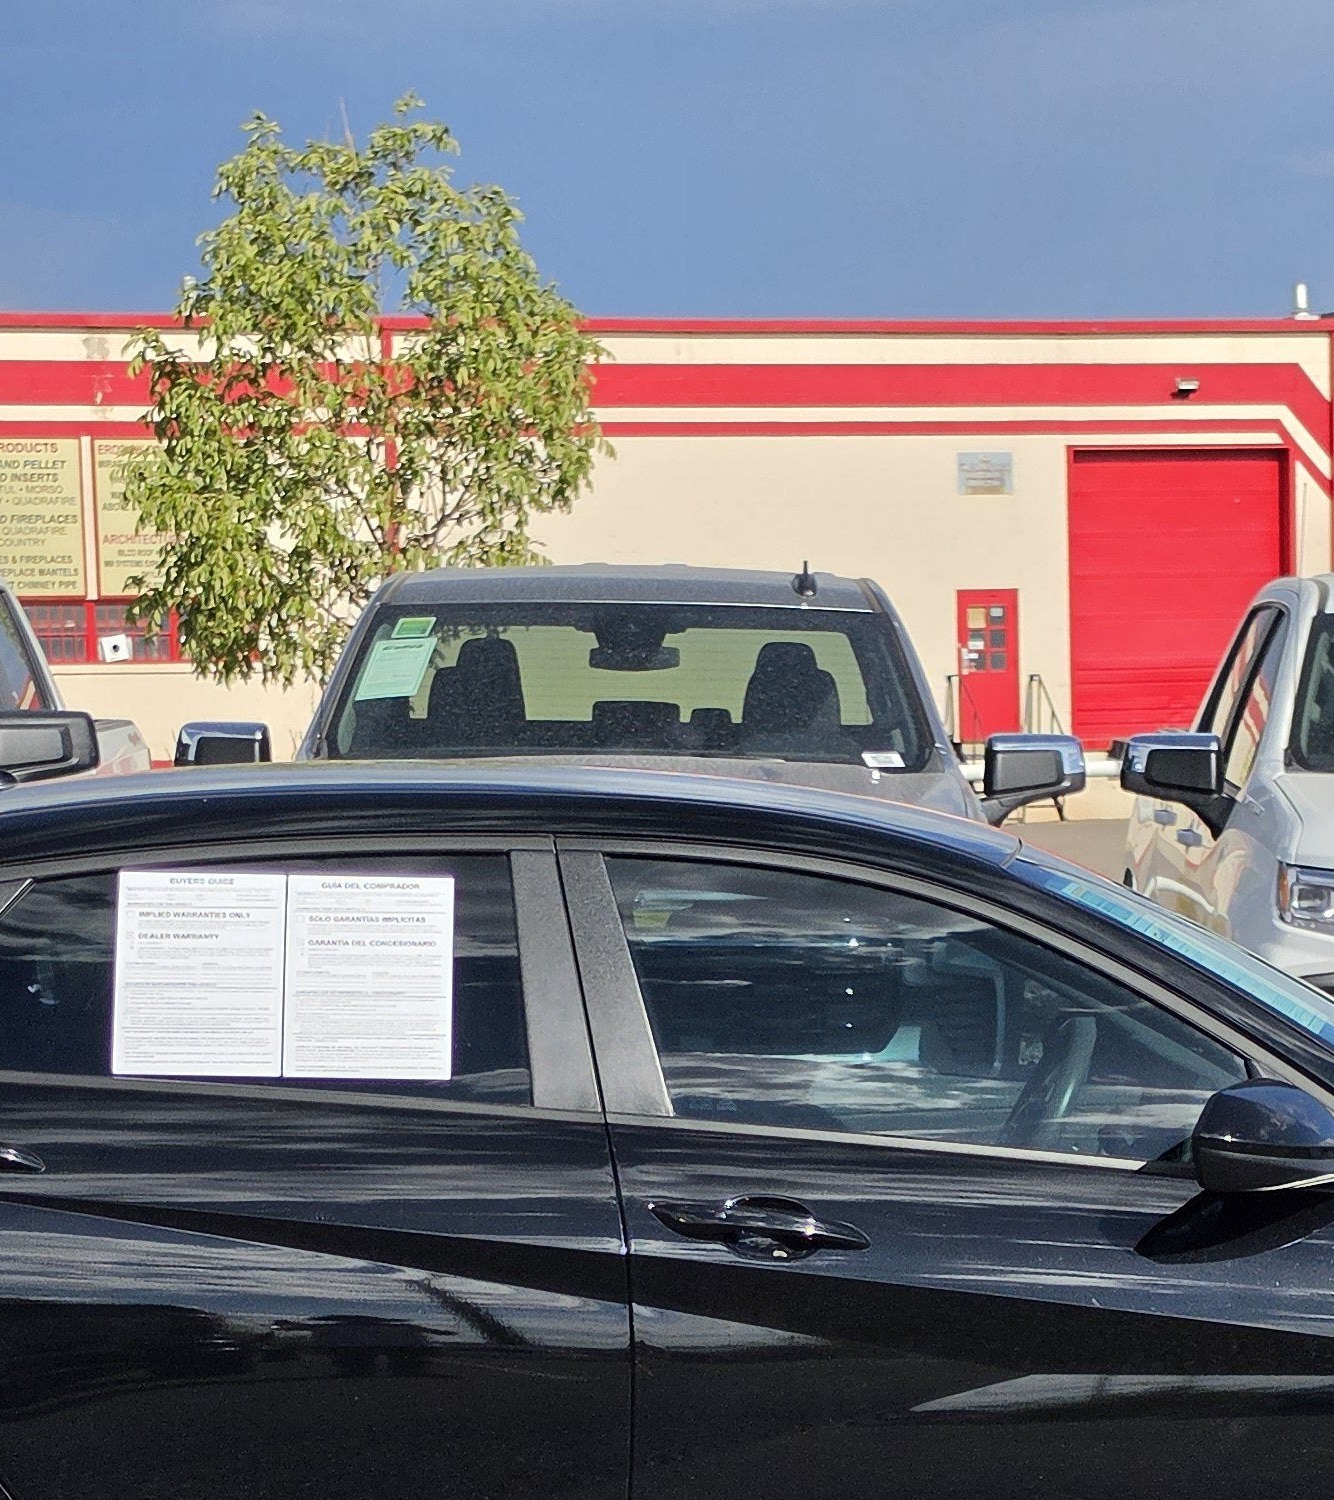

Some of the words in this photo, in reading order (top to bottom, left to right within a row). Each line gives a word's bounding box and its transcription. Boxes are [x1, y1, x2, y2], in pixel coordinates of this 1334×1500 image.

[23, 460, 67, 470] PELLET
[11, 473, 59, 482] INSERTS
[10, 514, 78, 524] FIREPLACES
[20, 556, 73, 564] FIREPLACES
[39, 568, 79, 577] MANTELS
